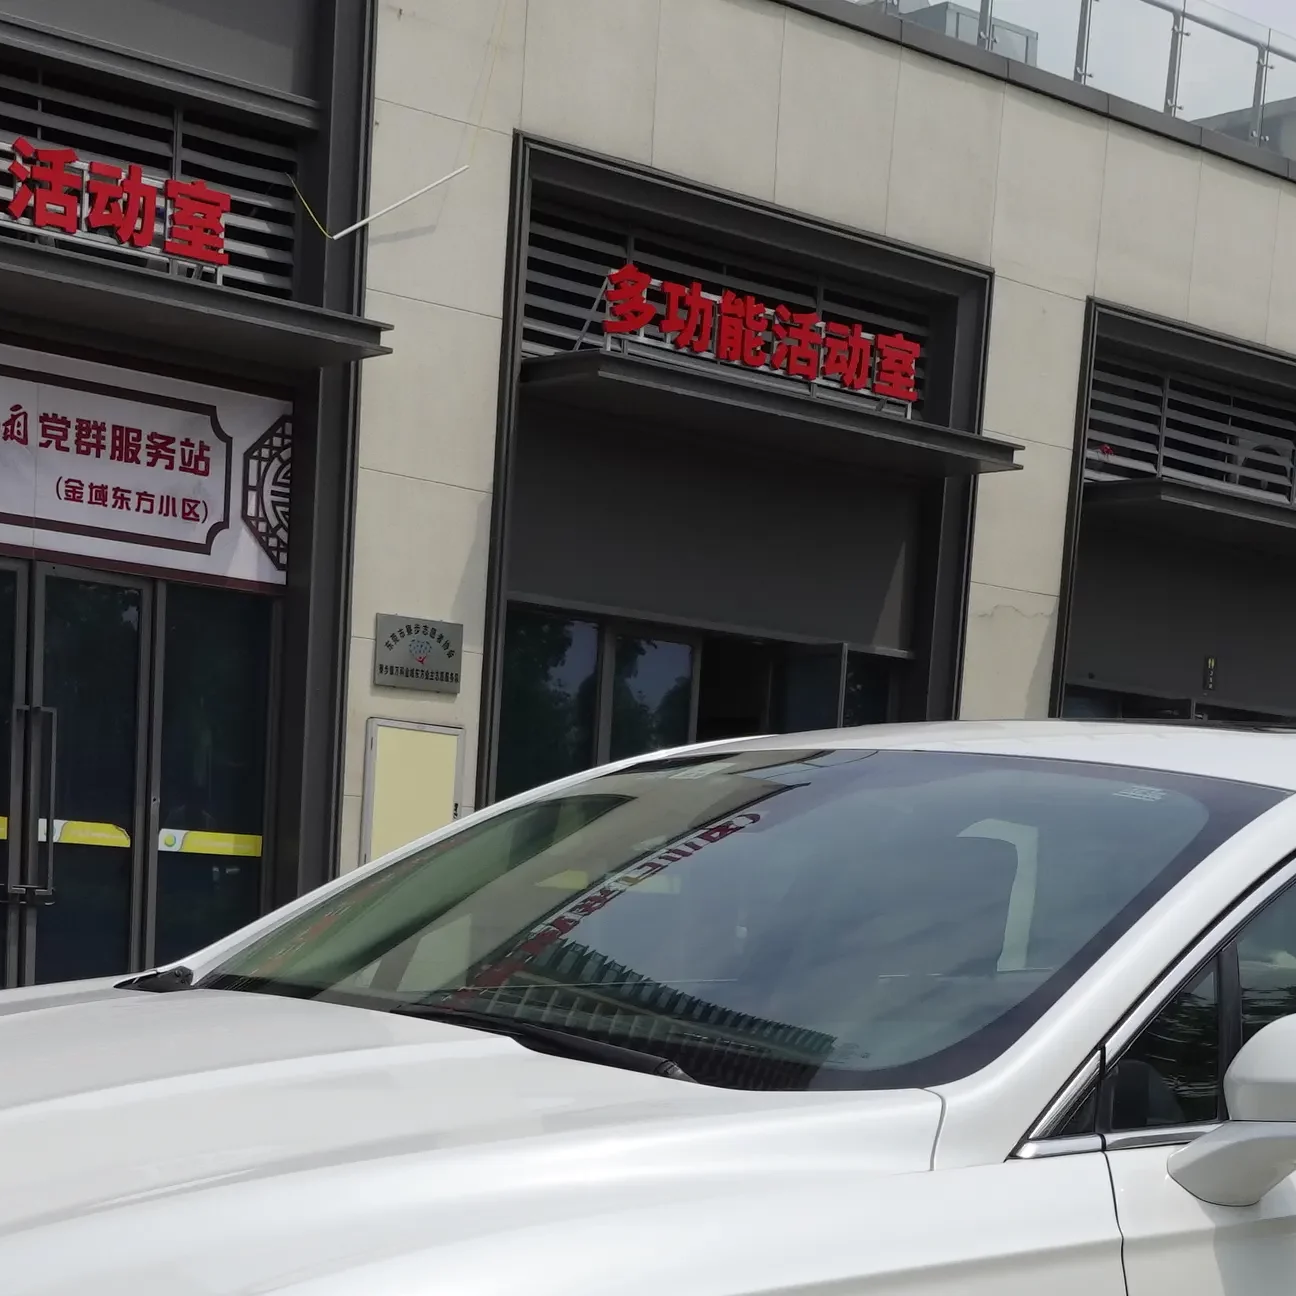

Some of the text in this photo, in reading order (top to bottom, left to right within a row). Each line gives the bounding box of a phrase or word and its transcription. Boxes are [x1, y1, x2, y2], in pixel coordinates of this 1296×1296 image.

[603, 263, 920, 402] 多功能活动室
